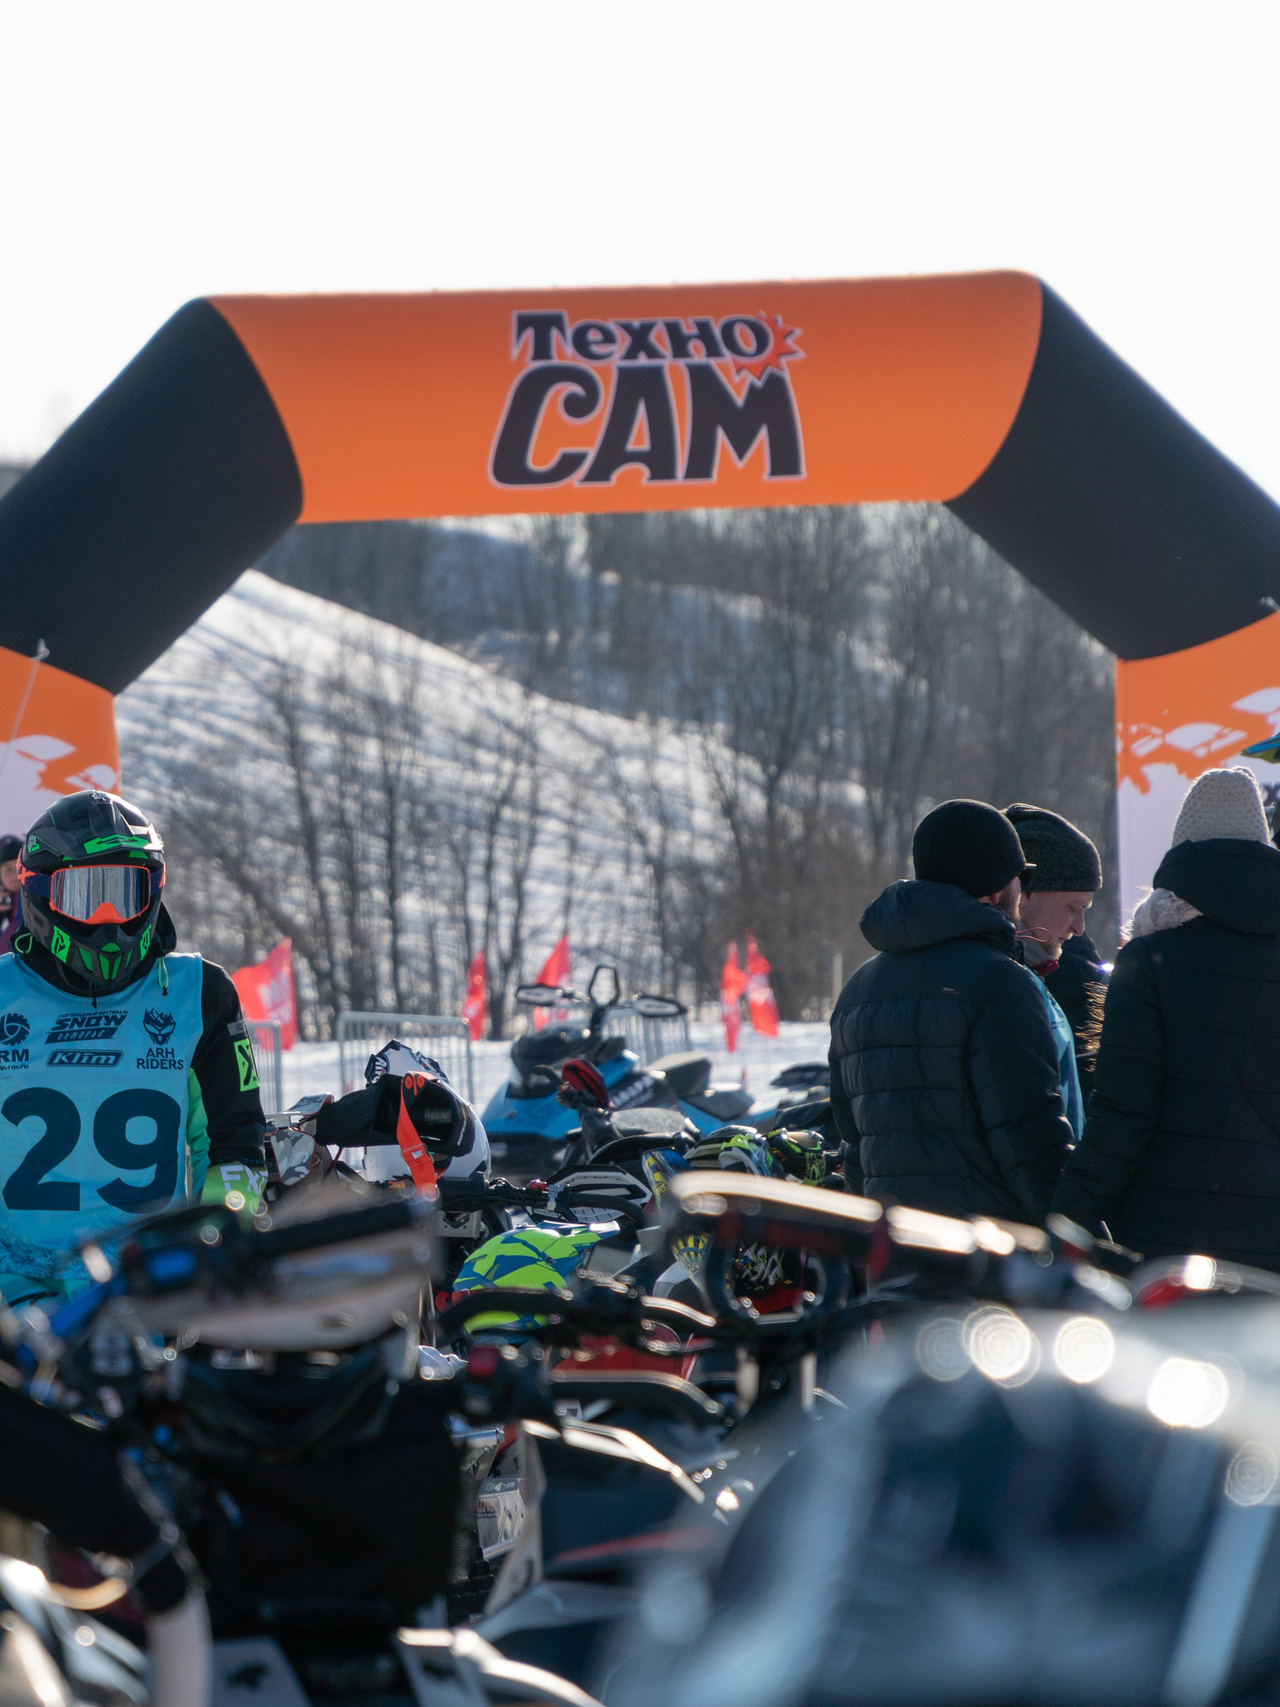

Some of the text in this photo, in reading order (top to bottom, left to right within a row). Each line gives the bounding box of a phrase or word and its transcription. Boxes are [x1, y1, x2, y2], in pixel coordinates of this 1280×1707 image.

[51, 1014, 128, 1031] SNOW
[57, 1029, 105, 1041] ПОМОРЬЕ
[146, 1047, 175, 1059] ARH
[136, 1058, 185, 1071] RIDERS
[1, 1086, 182, 1214] 29
